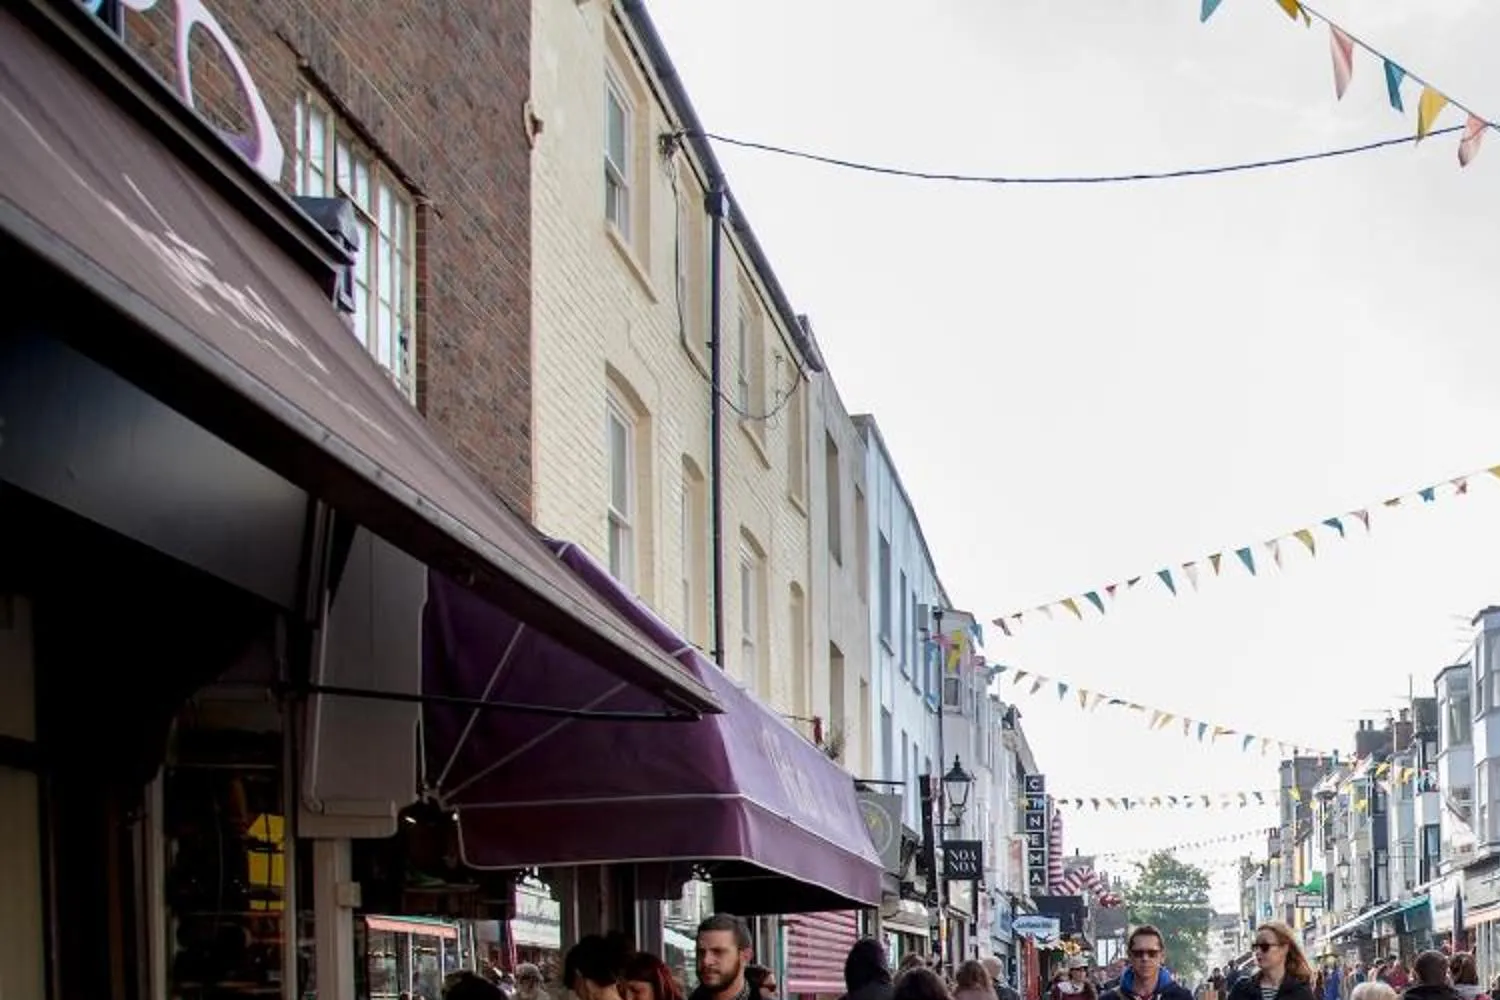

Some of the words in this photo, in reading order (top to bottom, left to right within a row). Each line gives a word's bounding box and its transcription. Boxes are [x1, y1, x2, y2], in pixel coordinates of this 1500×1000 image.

[1028, 779, 1042, 883] CINEMA
[950, 850, 977, 861] NOA
[950, 862, 977, 873] NOA
